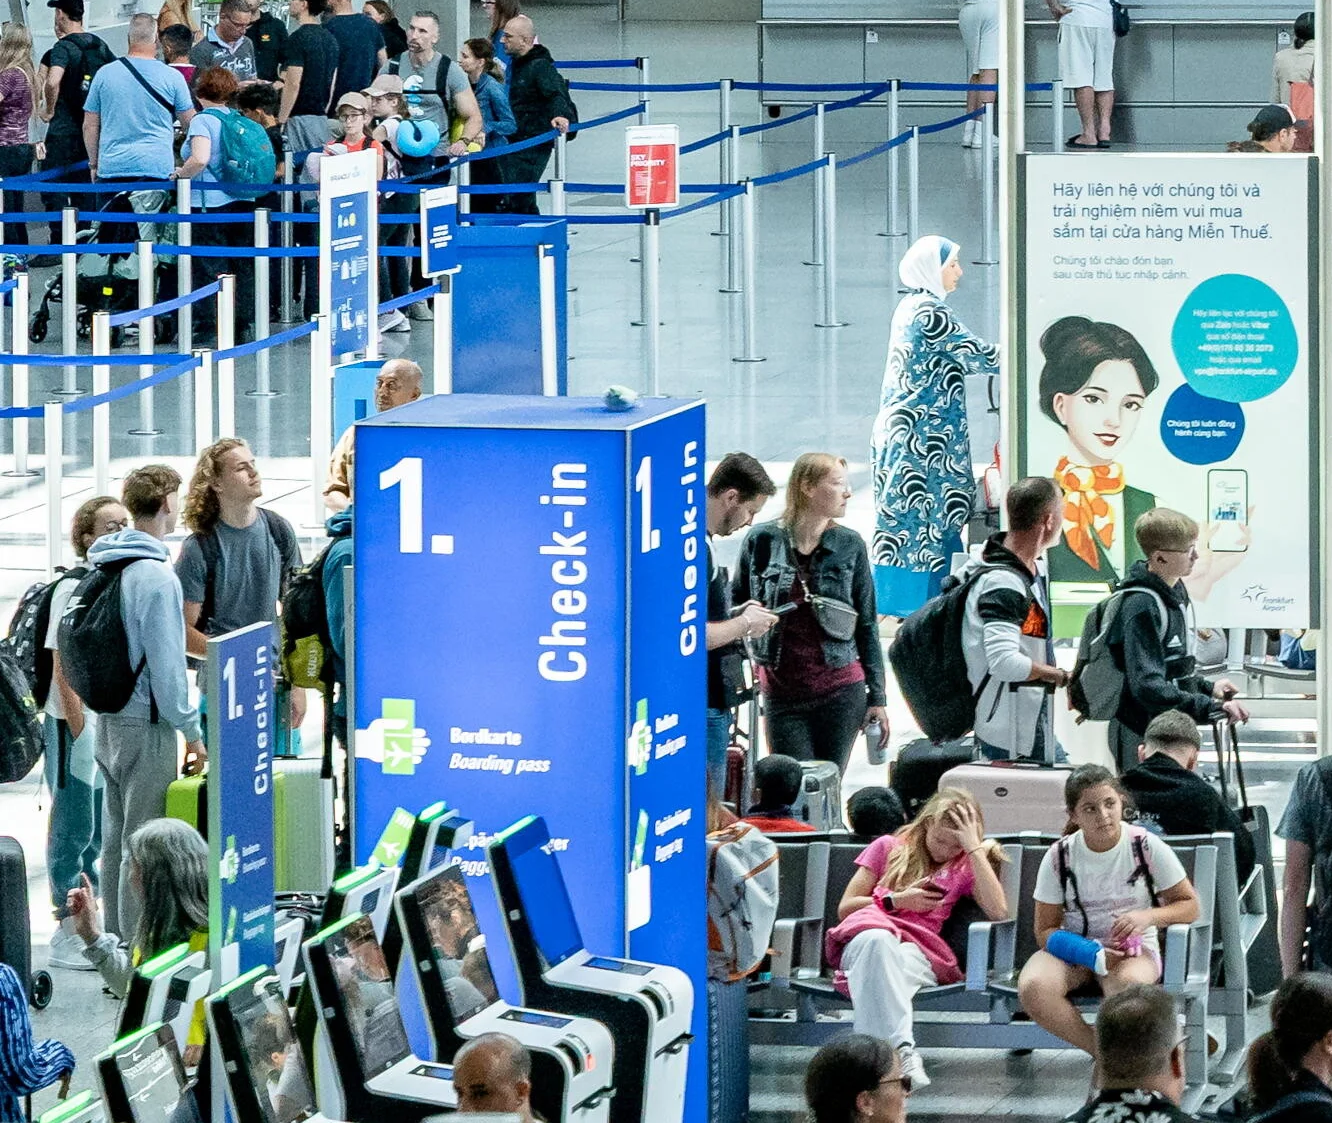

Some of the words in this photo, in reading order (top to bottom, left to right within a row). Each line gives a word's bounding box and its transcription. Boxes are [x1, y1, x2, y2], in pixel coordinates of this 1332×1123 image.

[1053, 183, 1083, 200] Hãy
[1088, 183, 1114, 197] liên
[1119, 183, 1138, 200] hệ
[1142, 183, 1164, 197] với
[1169, 183, 1215, 200] chúng
[1220, 183, 1238, 197] tôi
[1242, 184, 1260, 197] và
[1053, 203, 1076, 218] trải
[1082, 204, 1136, 220] nghiệm
[1142, 202, 1178, 218] niềm
[1183, 206, 1205, 218] vui
[1210, 207, 1242, 218] mua
[1053, 222, 1085, 238] sắm
[1090, 225, 1107, 242] tại
[1112, 224, 1141, 238] cửa
[1146, 225, 1183, 241] hàng
[1188, 222, 1224, 238] Miễn
[1230, 223, 1273, 239] Thuế.
[379, 457, 454, 554] 1.
[635, 456, 660, 553] 1.
[538, 462, 588, 682] Check-in
[680, 441, 697, 656] Check-in
[223, 656, 243, 720] 1.
[254, 645, 269, 795] Check-in
[449, 753, 514, 775] Boarding
[515, 758, 551, 775] pass
[450, 727, 522, 746] Bordkarte
